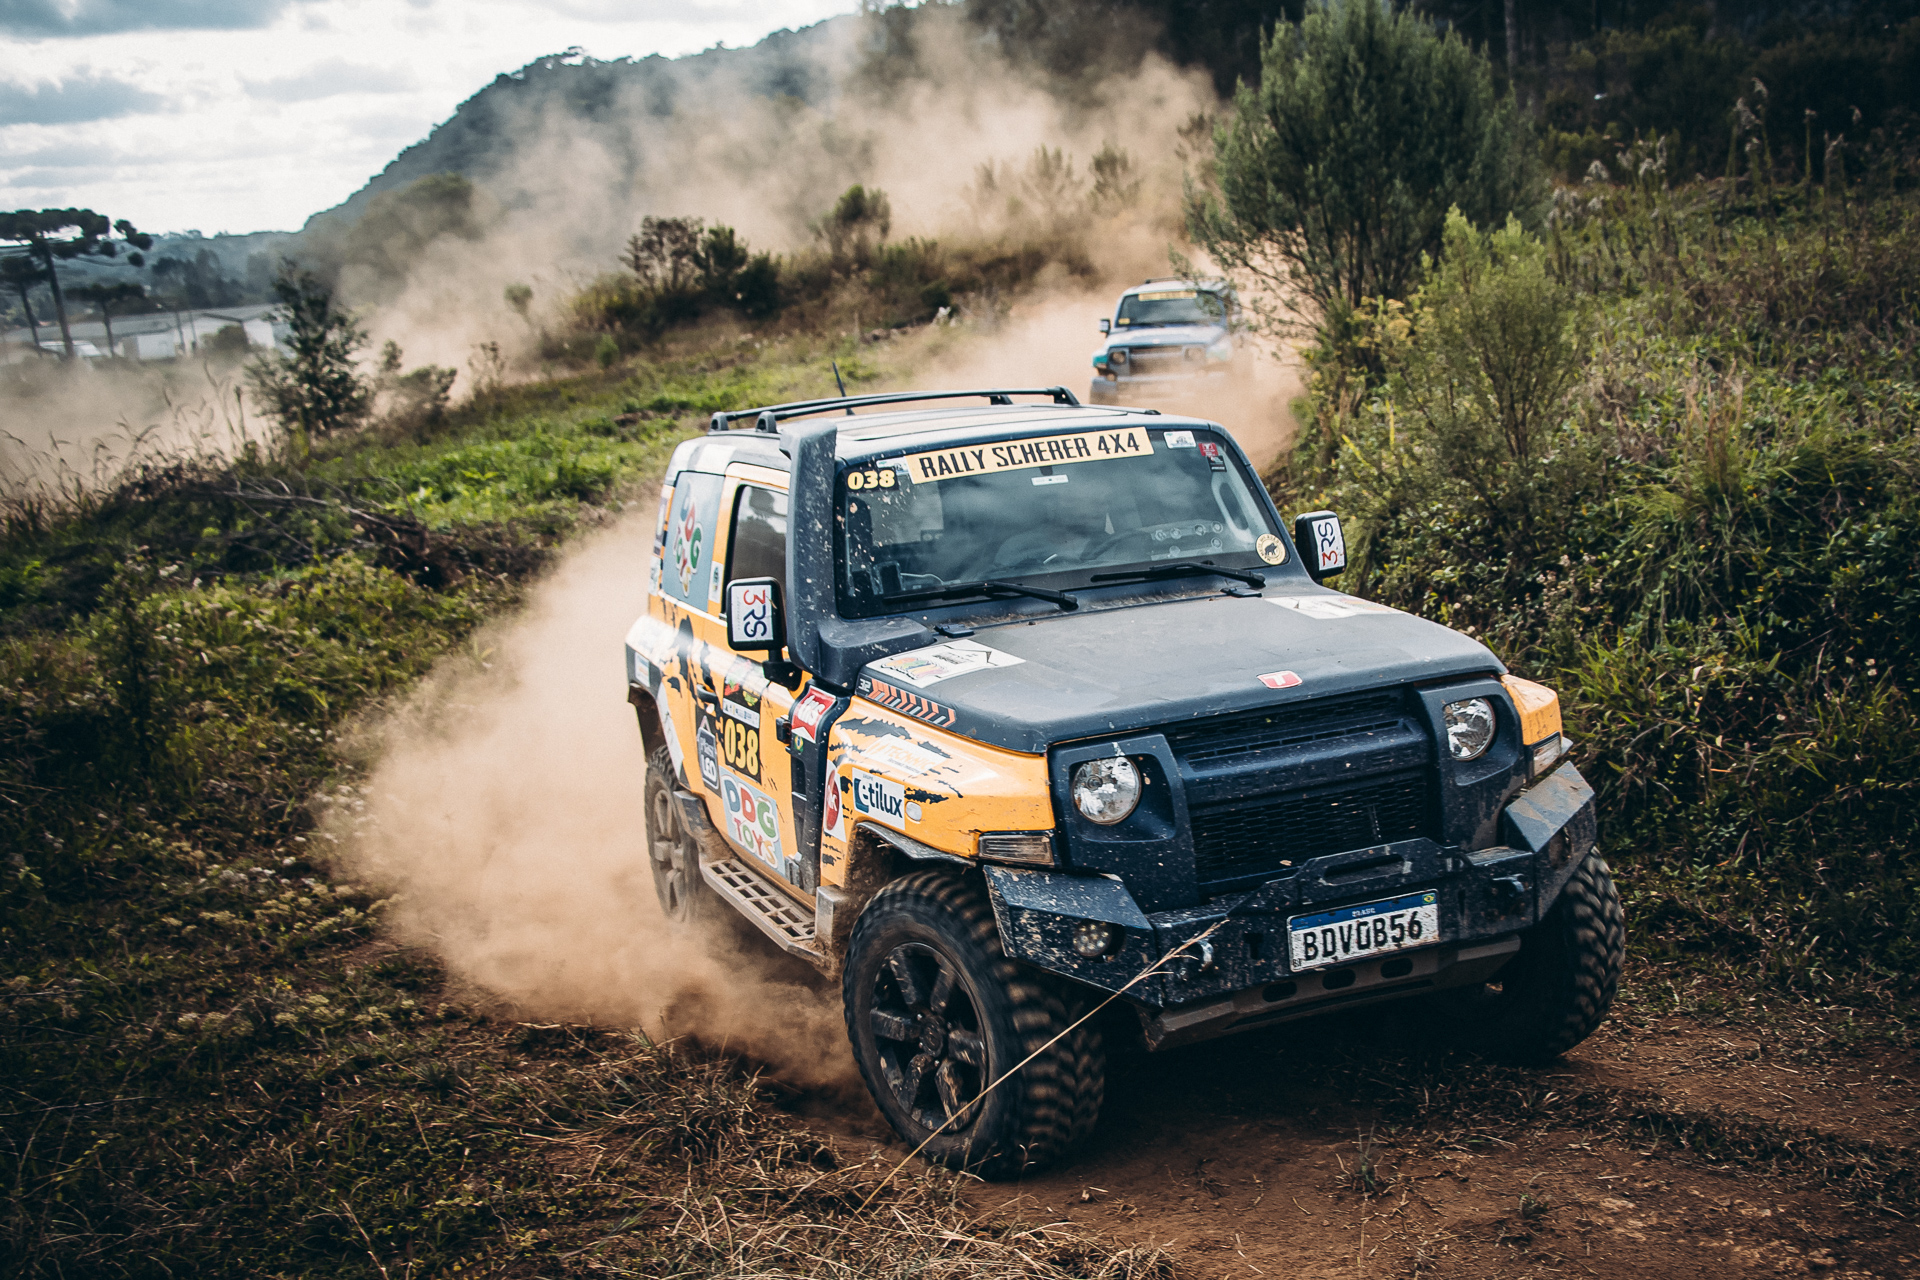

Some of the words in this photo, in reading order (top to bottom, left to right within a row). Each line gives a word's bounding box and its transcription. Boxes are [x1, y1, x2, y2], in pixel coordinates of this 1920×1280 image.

[919, 448, 985, 478] RALLY
[991, 437, 1092, 468] SCHERER
[1098, 432, 1140, 455] 4X4
[847, 469, 896, 490] 038
[743, 589, 768, 638] 3RS
[858, 678, 871, 692] 32
[724, 718, 759, 776] 038
[724, 779, 777, 839] DDG
[734, 817, 776, 865] TOYS
